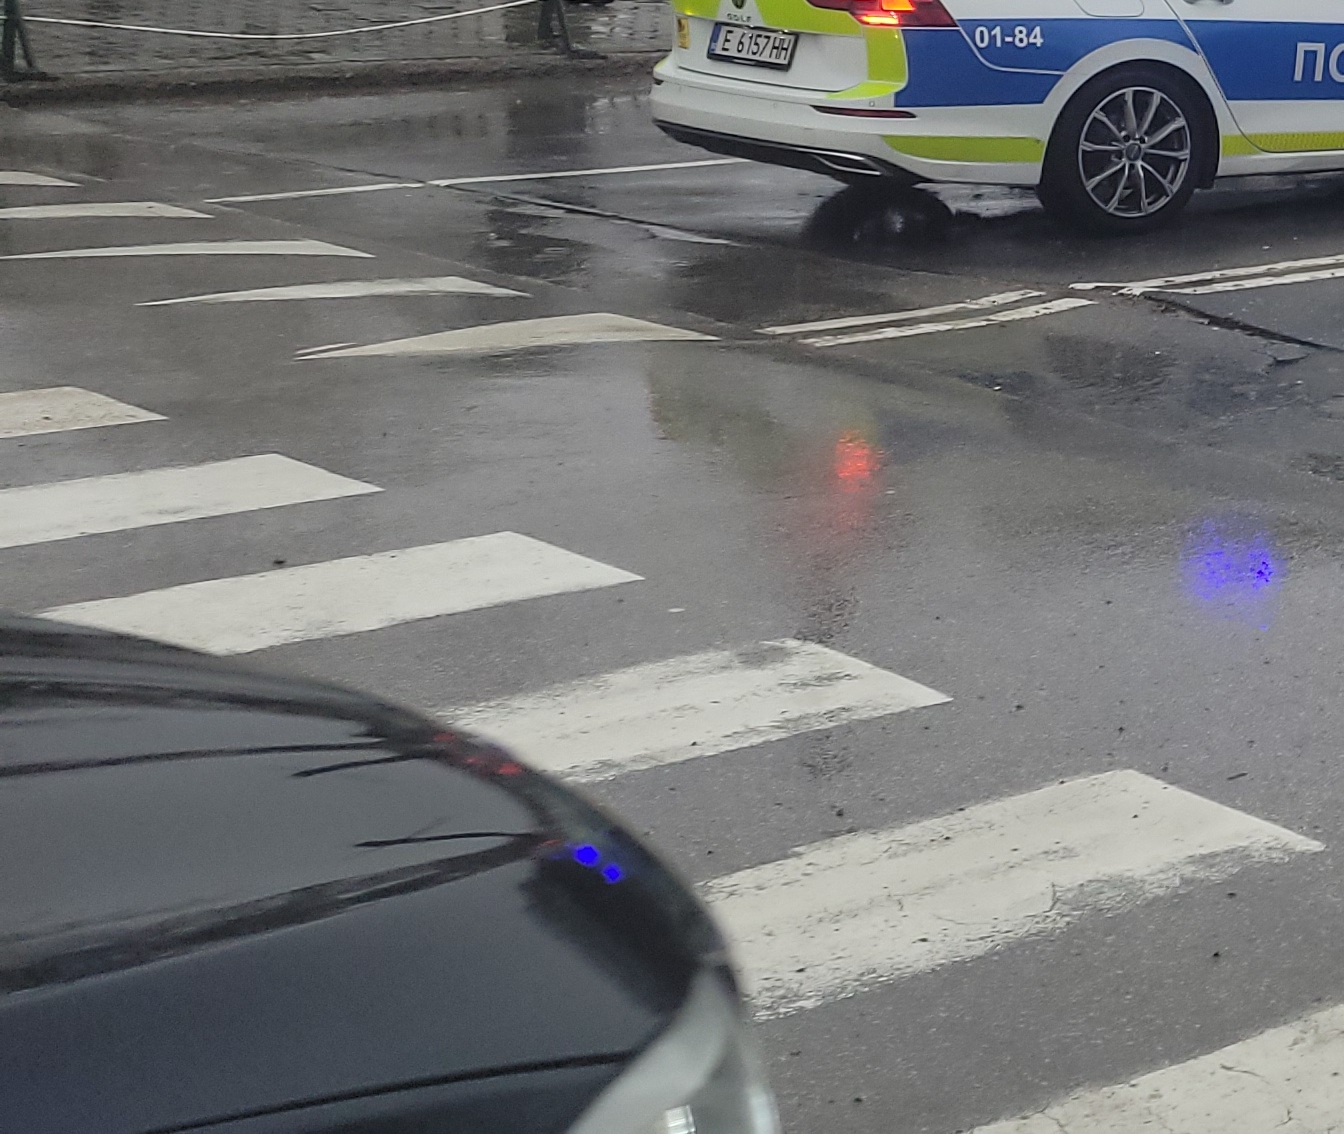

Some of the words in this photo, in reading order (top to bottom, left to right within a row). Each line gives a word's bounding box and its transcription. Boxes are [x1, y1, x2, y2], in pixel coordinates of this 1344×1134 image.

[721, 30, 734, 52] E
[737, 31, 771, 58] 6157
[769, 36, 792, 61] HH
[975, 25, 1044, 48] 01-84
